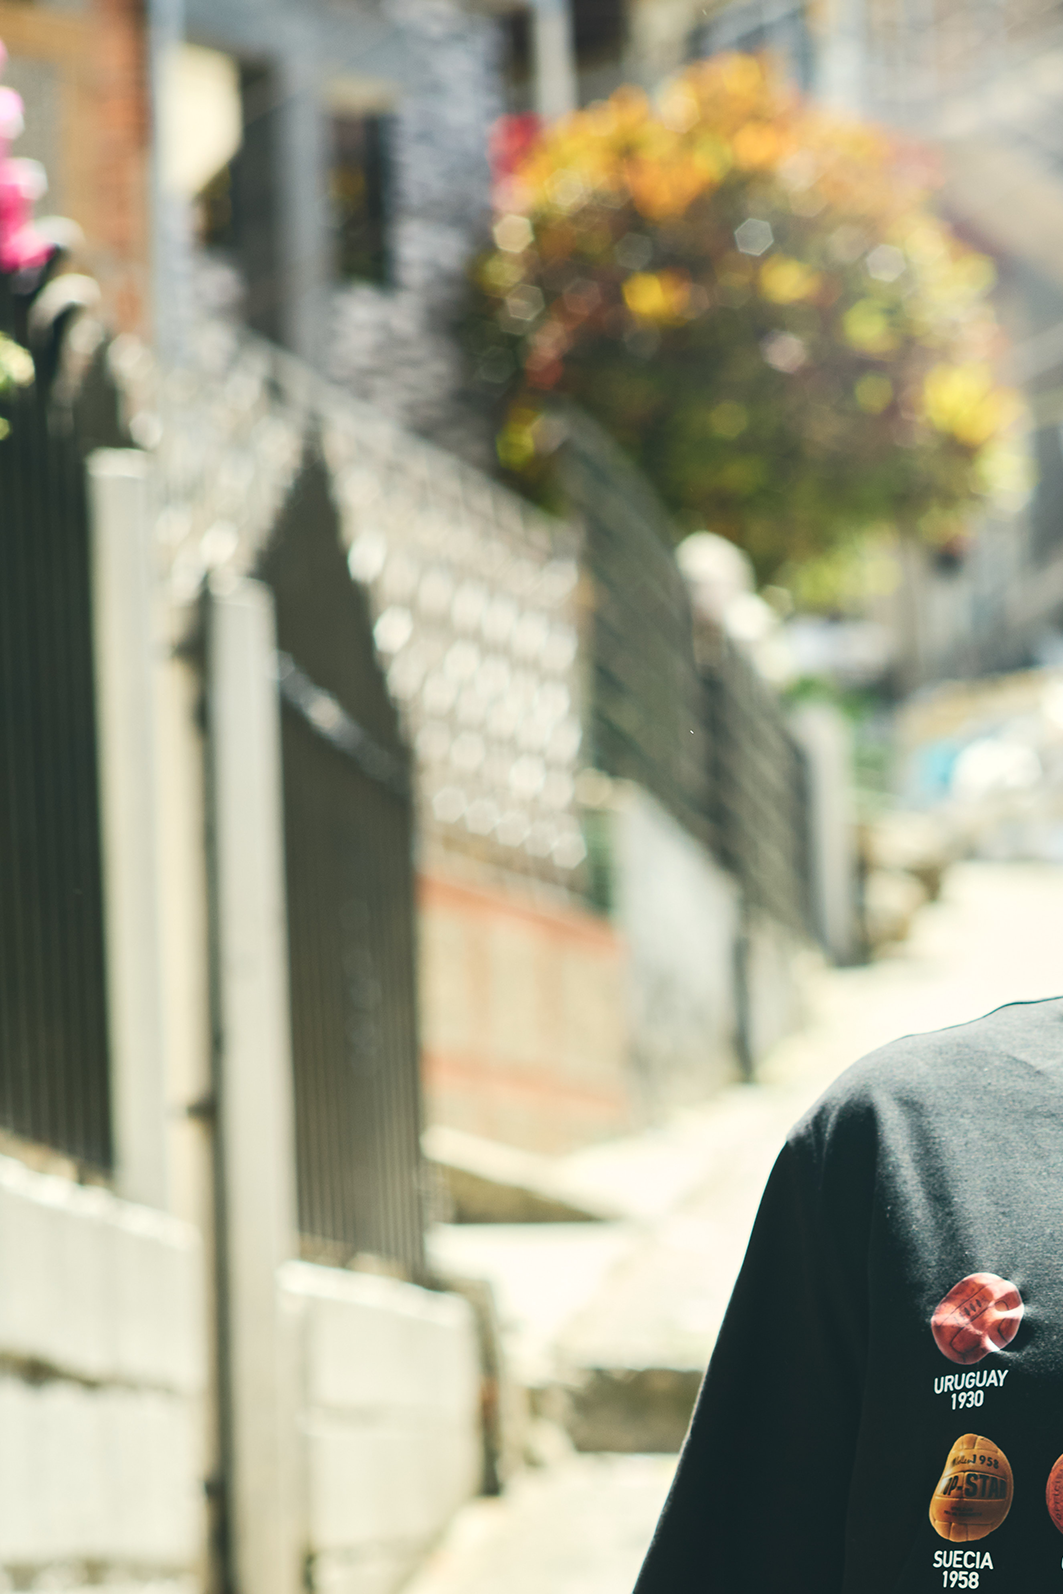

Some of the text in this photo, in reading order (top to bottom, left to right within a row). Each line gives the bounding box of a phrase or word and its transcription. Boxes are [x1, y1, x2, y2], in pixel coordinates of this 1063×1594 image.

[933, 1369, 1009, 1394] URUGUAY
[951, 1389, 984, 1410] 1930
[972, 1454, 999, 1469] 1958
[932, 1550, 994, 1570] SUECIA
[942, 1570, 980, 1590] 1958
